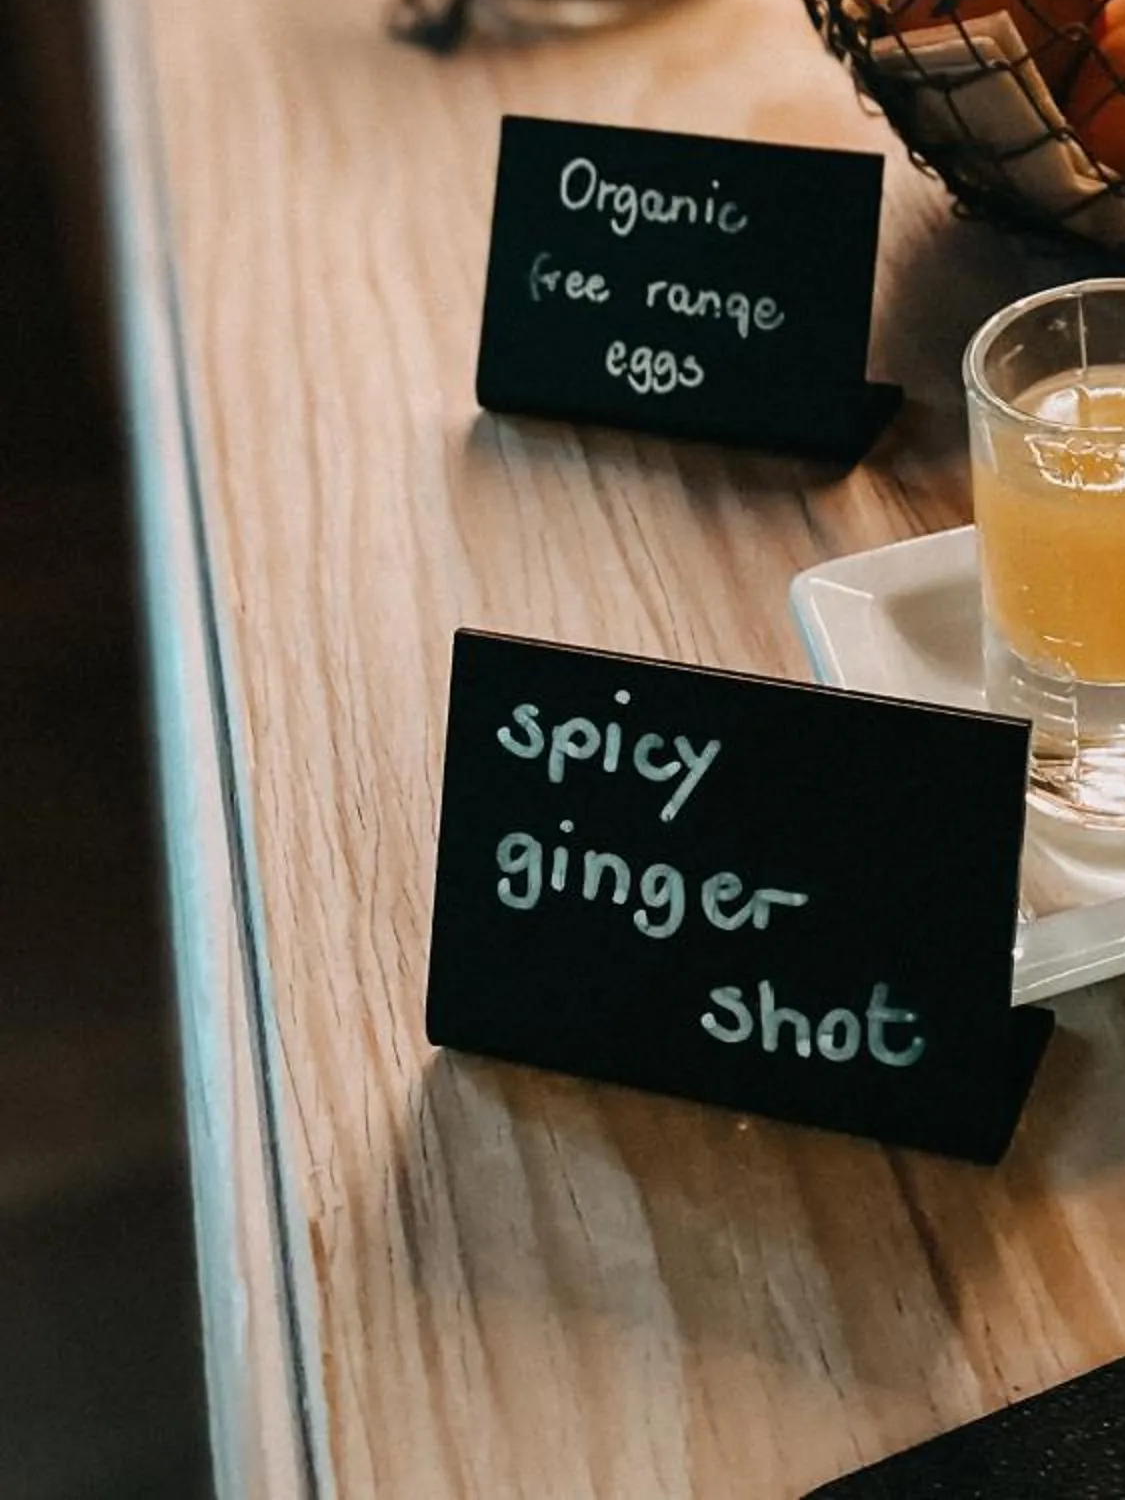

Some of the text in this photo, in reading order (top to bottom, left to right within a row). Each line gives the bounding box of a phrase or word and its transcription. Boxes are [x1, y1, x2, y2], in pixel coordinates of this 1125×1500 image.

[560, 157, 748, 237] Organic
[531, 252, 785, 339] free range
[605, 340, 705, 395] eggs
[496, 689, 721, 822] spicy
[496, 819, 809, 939] ginger
[700, 979, 924, 1067] shot
